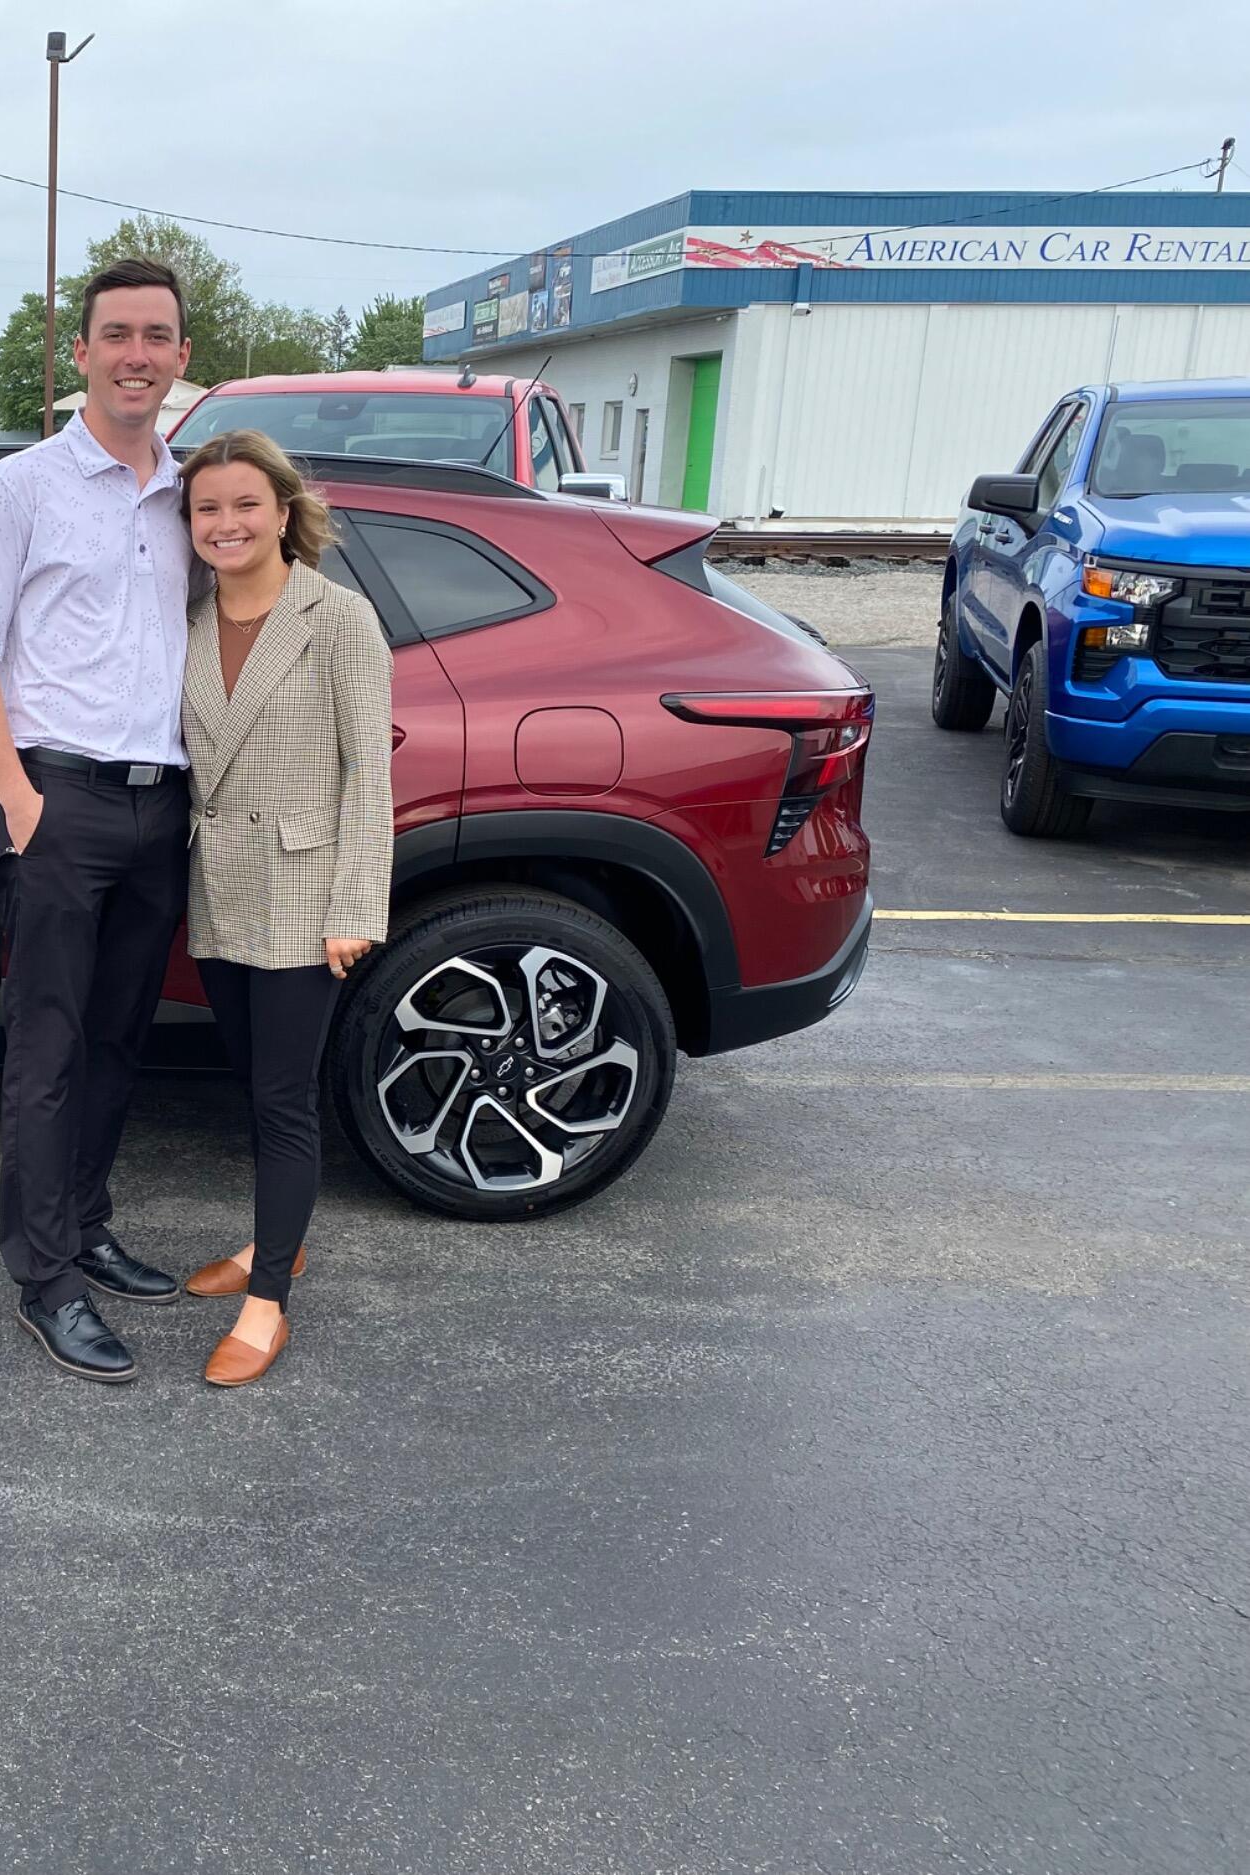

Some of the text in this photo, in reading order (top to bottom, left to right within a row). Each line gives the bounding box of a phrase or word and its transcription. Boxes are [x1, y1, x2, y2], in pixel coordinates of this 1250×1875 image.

[846, 231, 1250, 263] AMERICAN CAR RENTAL
